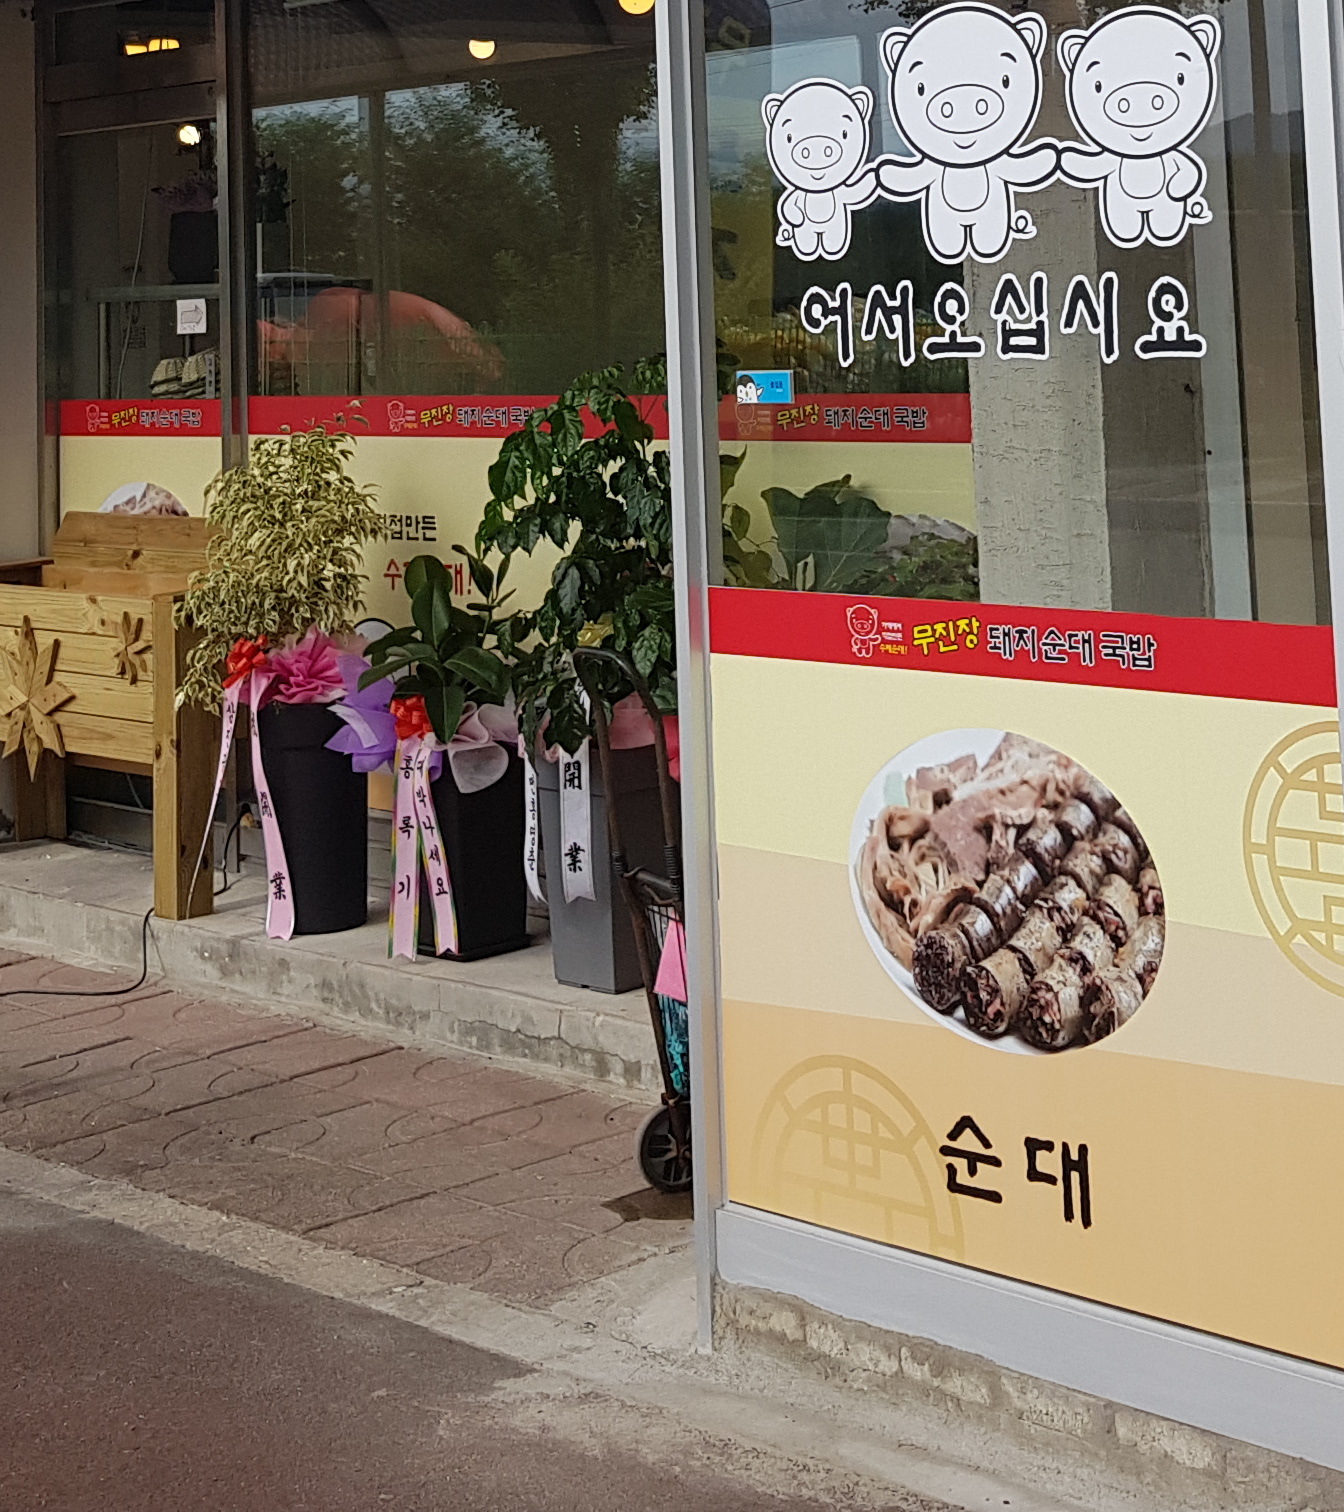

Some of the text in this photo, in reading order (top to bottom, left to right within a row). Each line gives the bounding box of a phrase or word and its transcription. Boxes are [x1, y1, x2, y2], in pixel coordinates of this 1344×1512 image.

[801, 271, 1206, 365] 어서오십시요
[112, 407, 137, 428] 무진장
[420, 404, 454, 427] 무진장
[457, 406, 508, 427] 돼지순대
[777, 404, 820, 430] 무진장
[824, 407, 890, 430] 돼지순대
[894, 406, 927, 430] 국밥
[913, 616, 1156, 670] 무진장 돼지순대 국밥
[939, 1114, 1092, 1230] 순대
